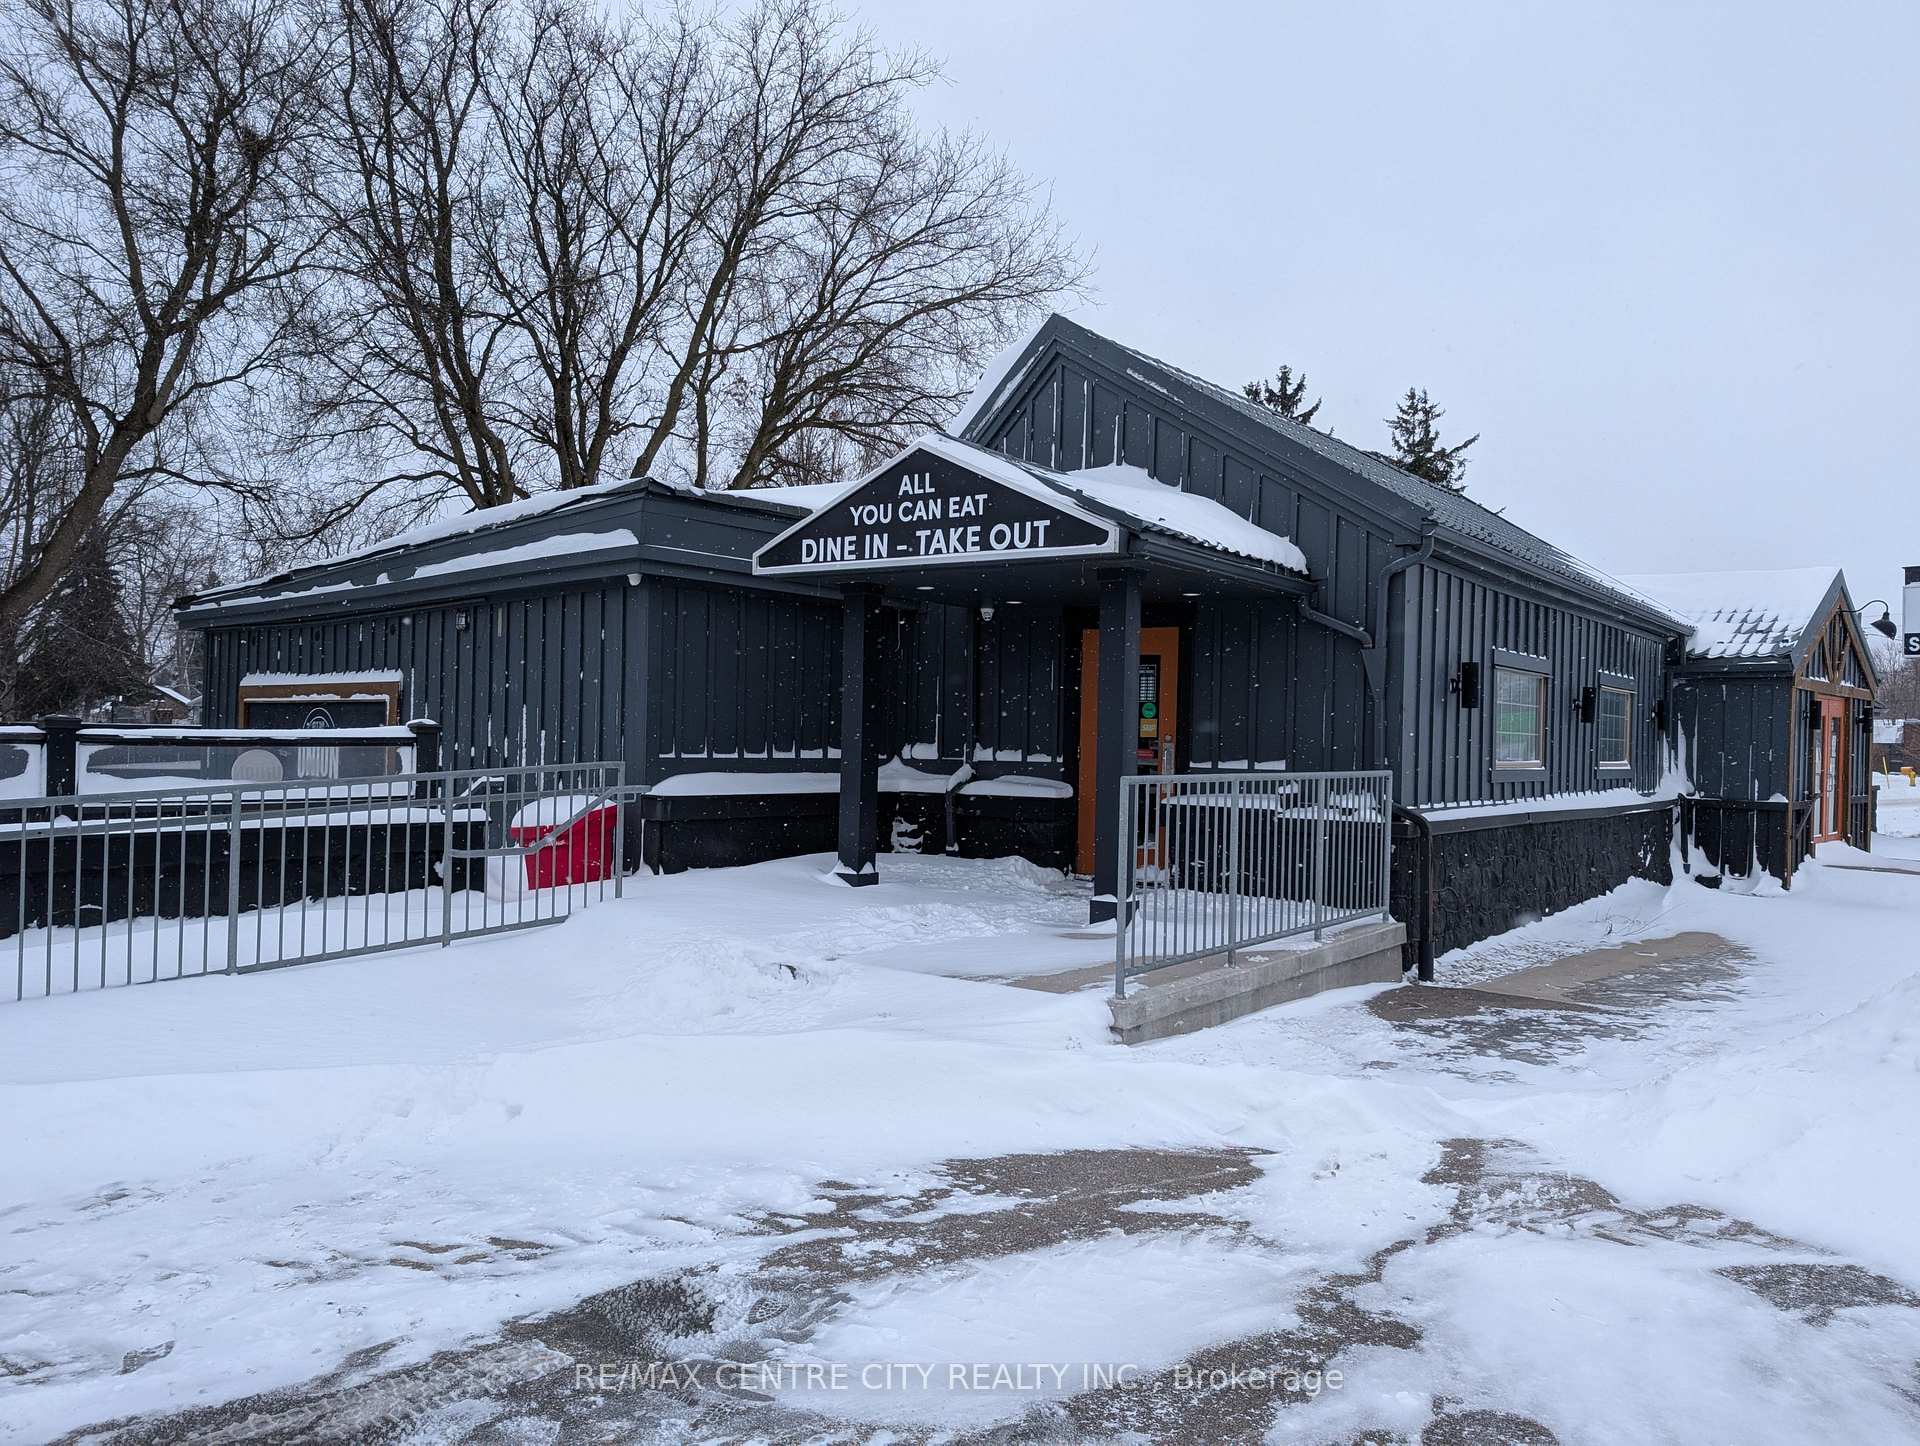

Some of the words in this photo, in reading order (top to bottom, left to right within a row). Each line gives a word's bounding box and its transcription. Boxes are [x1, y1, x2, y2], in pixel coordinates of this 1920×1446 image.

[898, 472, 936, 496] ALL
[850, 503, 893, 526] YOU
[898, 498, 942, 522] CAN
[948, 494, 988, 518] EAT
[801, 535, 857, 563] DINE
[864, 533, 889, 559] IN
[916, 525, 981, 555] TAKE
[989, 520, 1050, 549] OUT
